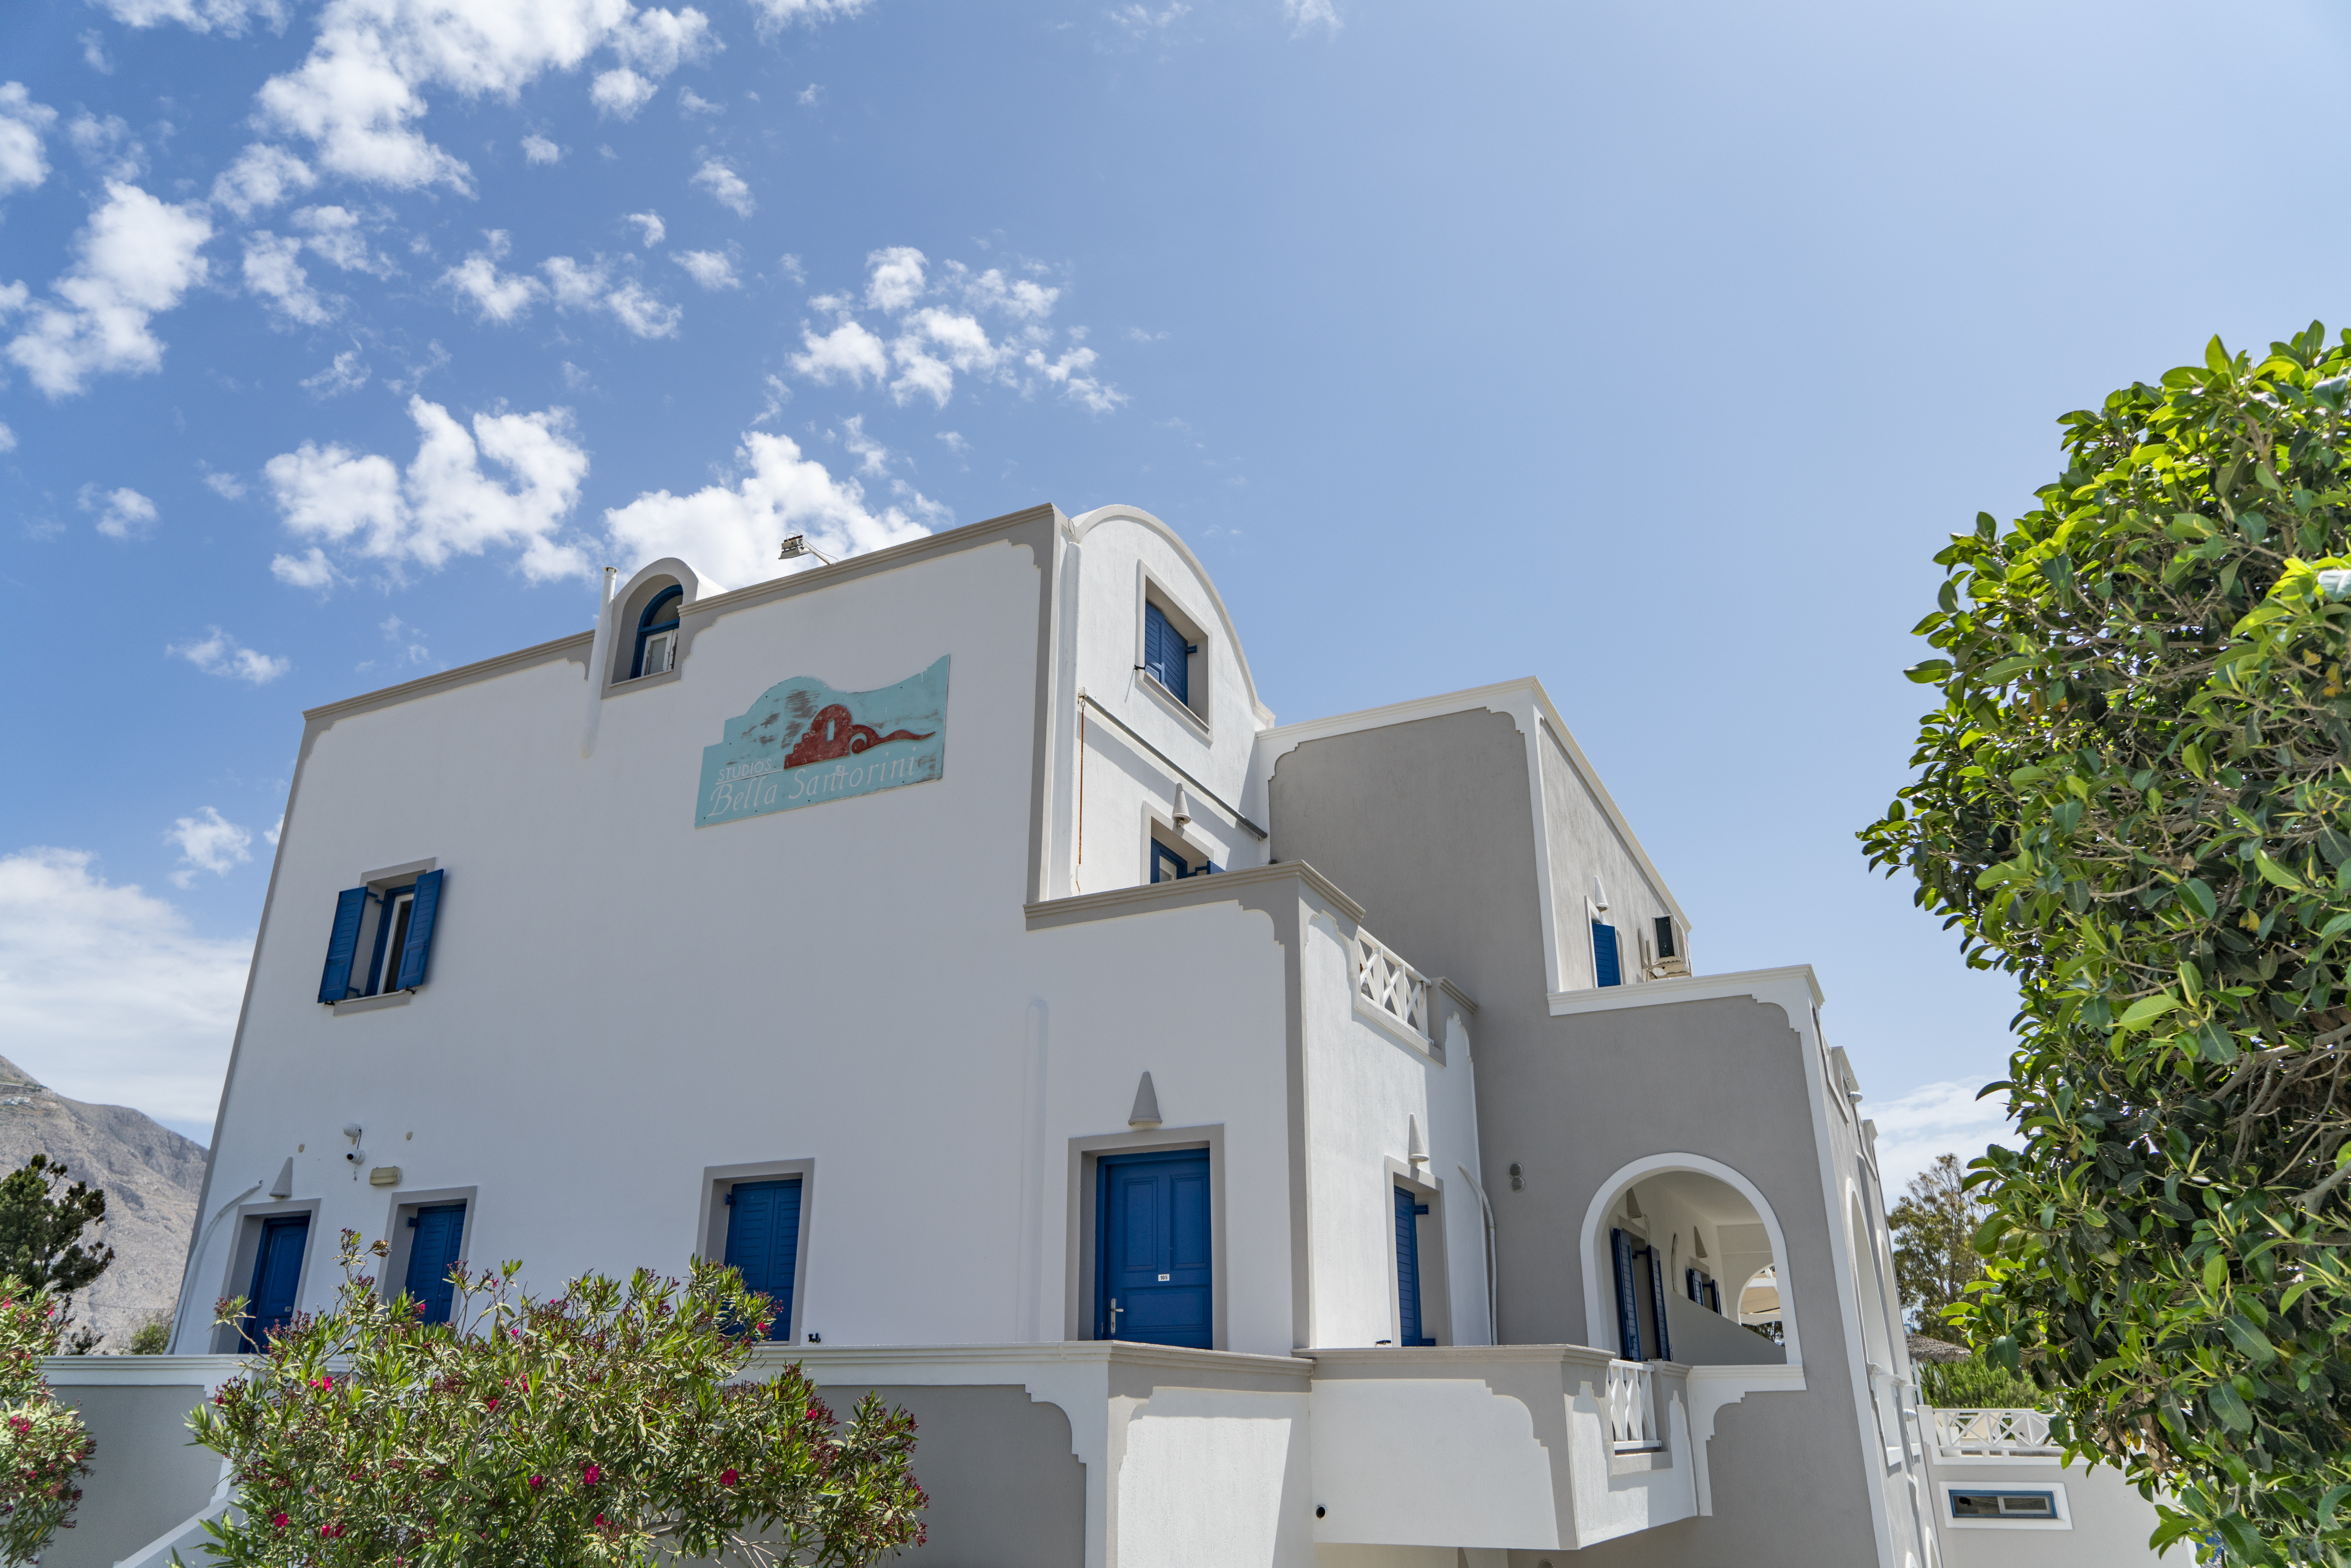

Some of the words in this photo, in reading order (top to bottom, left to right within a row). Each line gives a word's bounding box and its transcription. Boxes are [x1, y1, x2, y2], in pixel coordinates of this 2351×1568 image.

[707, 776, 779, 817] Bella
[788, 746, 916, 799] Santorini
[718, 758, 772, 782] STUDIOS
